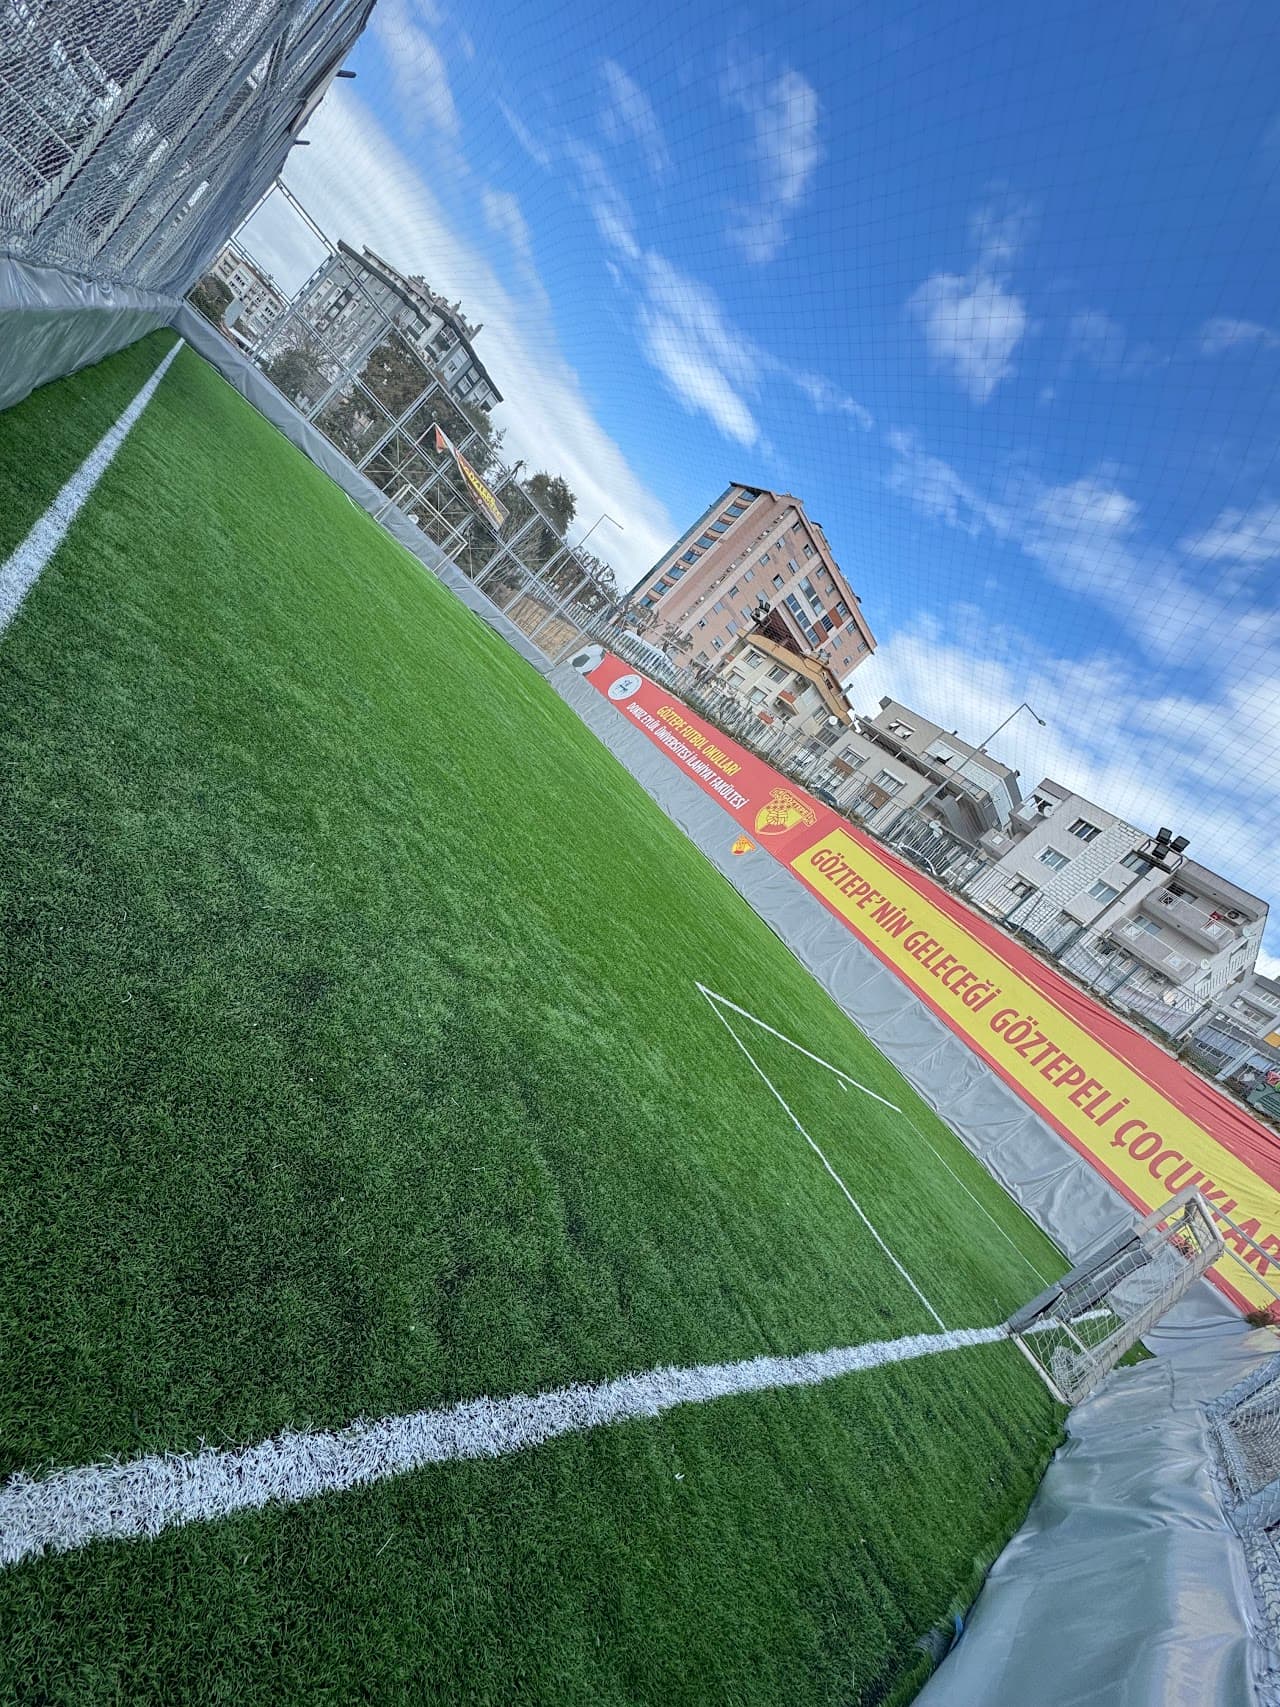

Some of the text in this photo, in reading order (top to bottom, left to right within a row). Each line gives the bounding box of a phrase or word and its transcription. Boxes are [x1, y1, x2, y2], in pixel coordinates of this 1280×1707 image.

[640, 715, 660, 732] EYLÜL
[709, 777, 750, 809] FAKÜLTESİ
[657, 706, 742, 776] GÖZTEPE FUTBOL OKULLARI
[810, 848, 914, 938] GÖZTEPE'NİN
[903, 930, 1002, 1013] GELECEĞİ
[989, 1008, 1130, 1127] GÖZTEPELİ
